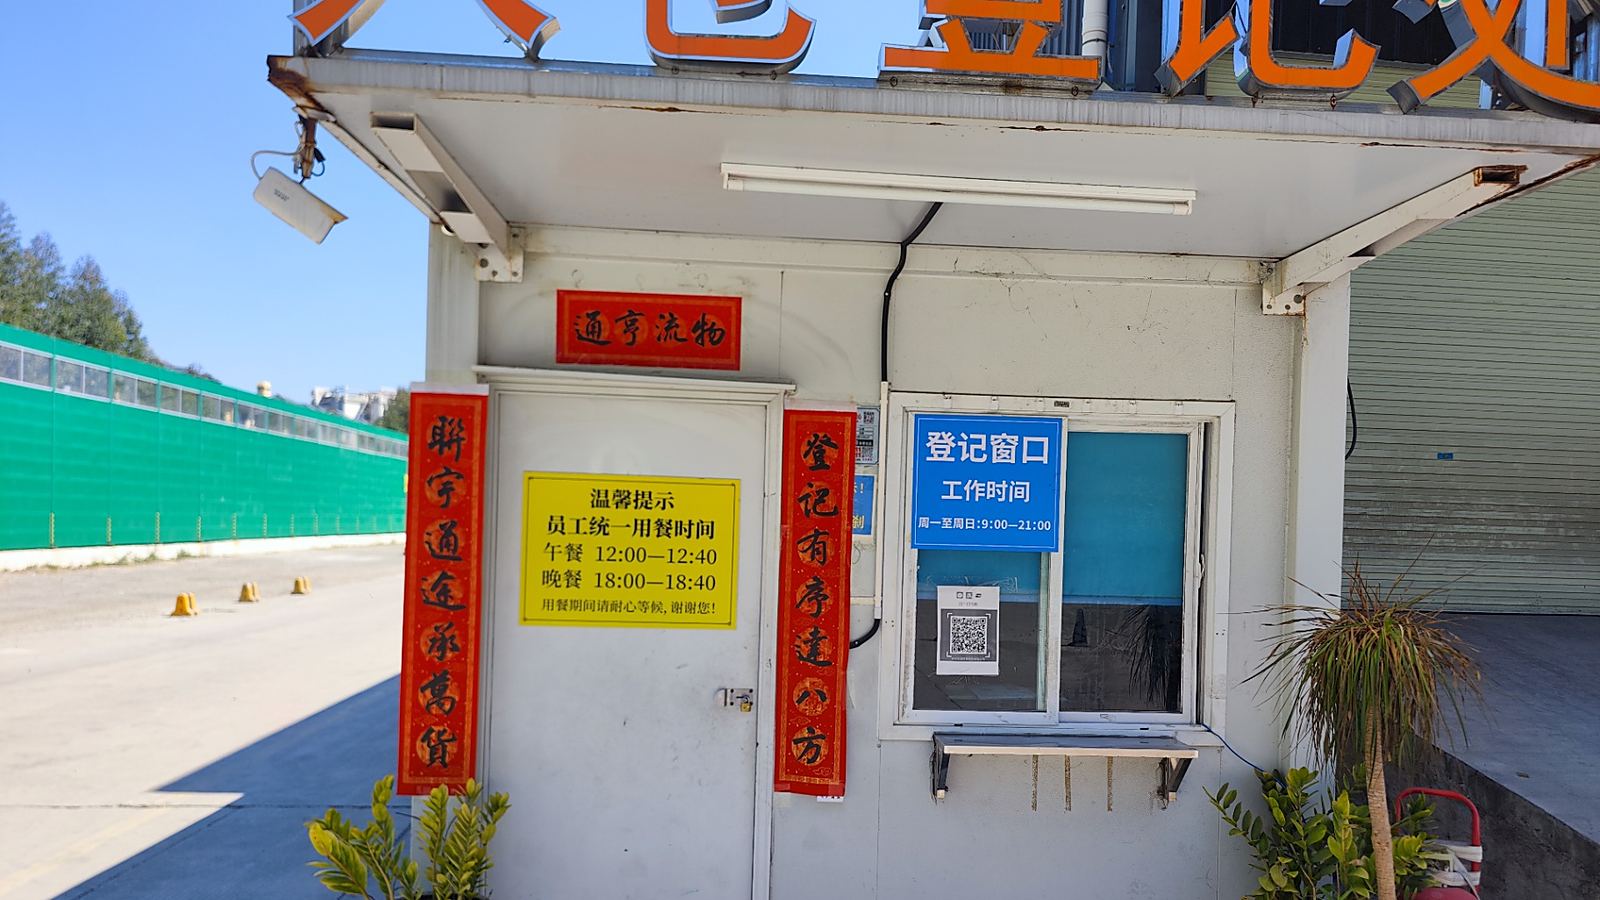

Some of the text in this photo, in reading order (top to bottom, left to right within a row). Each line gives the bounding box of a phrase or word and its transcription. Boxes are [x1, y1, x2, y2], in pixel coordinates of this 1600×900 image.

[925, 431, 1050, 464] 登记窗口
[590, 487, 675, 511] 温馨提示
[941, 479, 1031, 503] 工作时间
[547, 515, 715, 540] 员工统一用餐时间
[543, 542, 583, 563] 午餐
[541, 569, 582, 590] 晚餐
